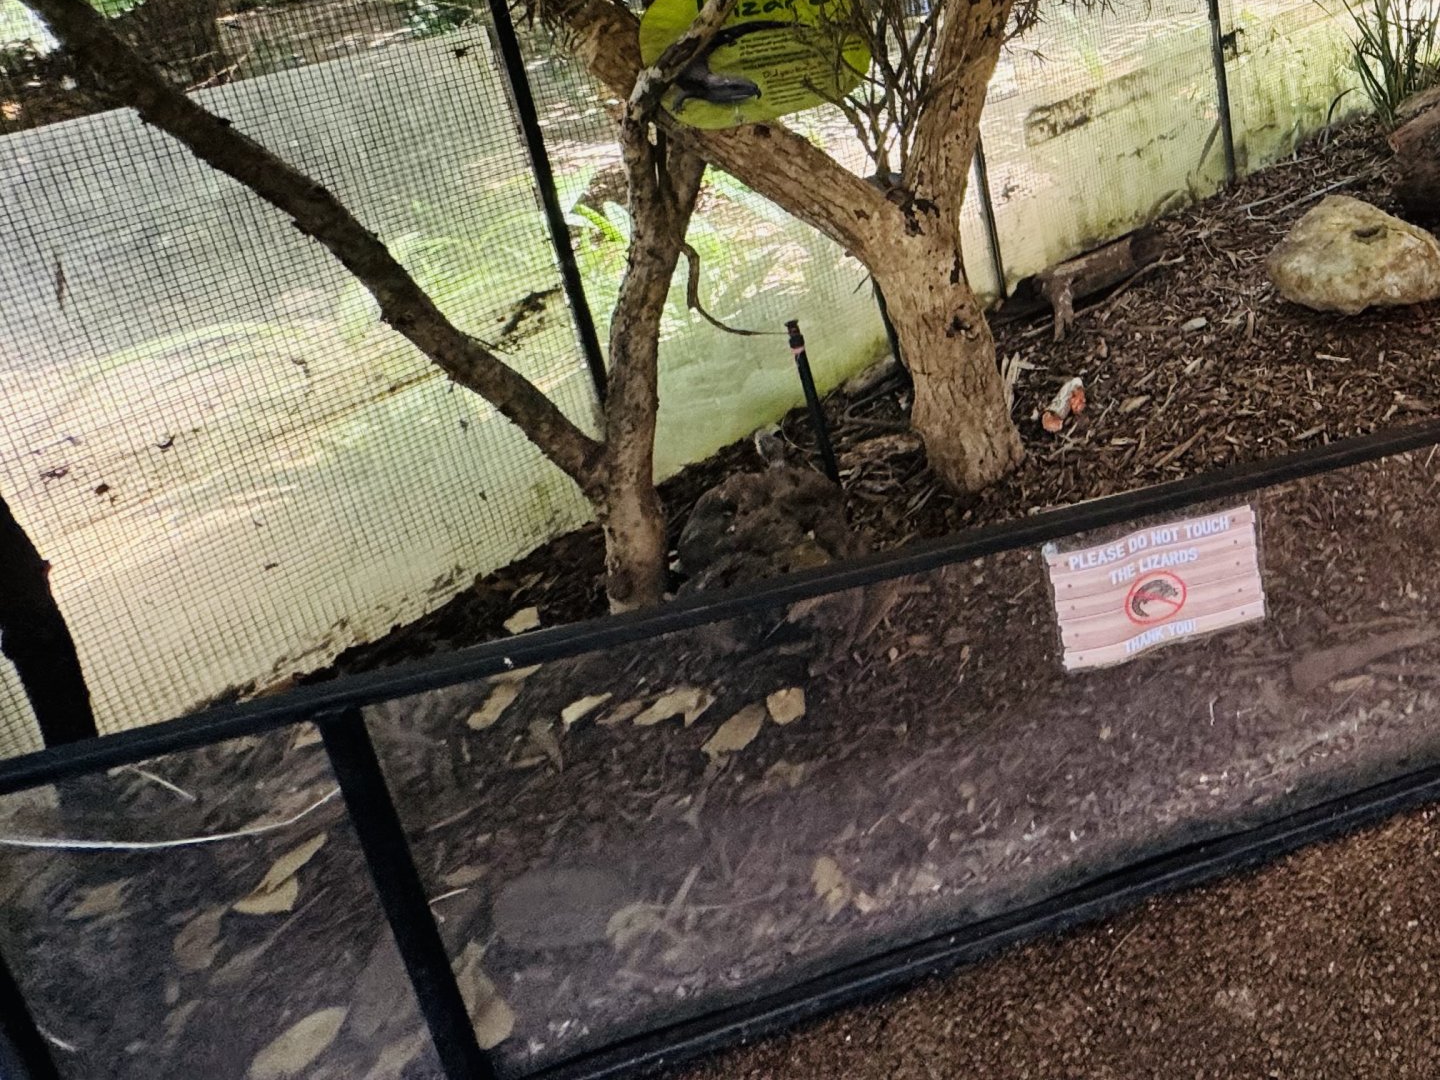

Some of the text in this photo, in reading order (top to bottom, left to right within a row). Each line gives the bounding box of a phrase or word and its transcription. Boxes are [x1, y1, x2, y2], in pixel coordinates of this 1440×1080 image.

[1068, 515, 1230, 571] PLEASE DO NOT TOUCH
[1109, 547, 1199, 585] THE LIZARDS
[1125, 619, 1197, 654] THANK YOU!
